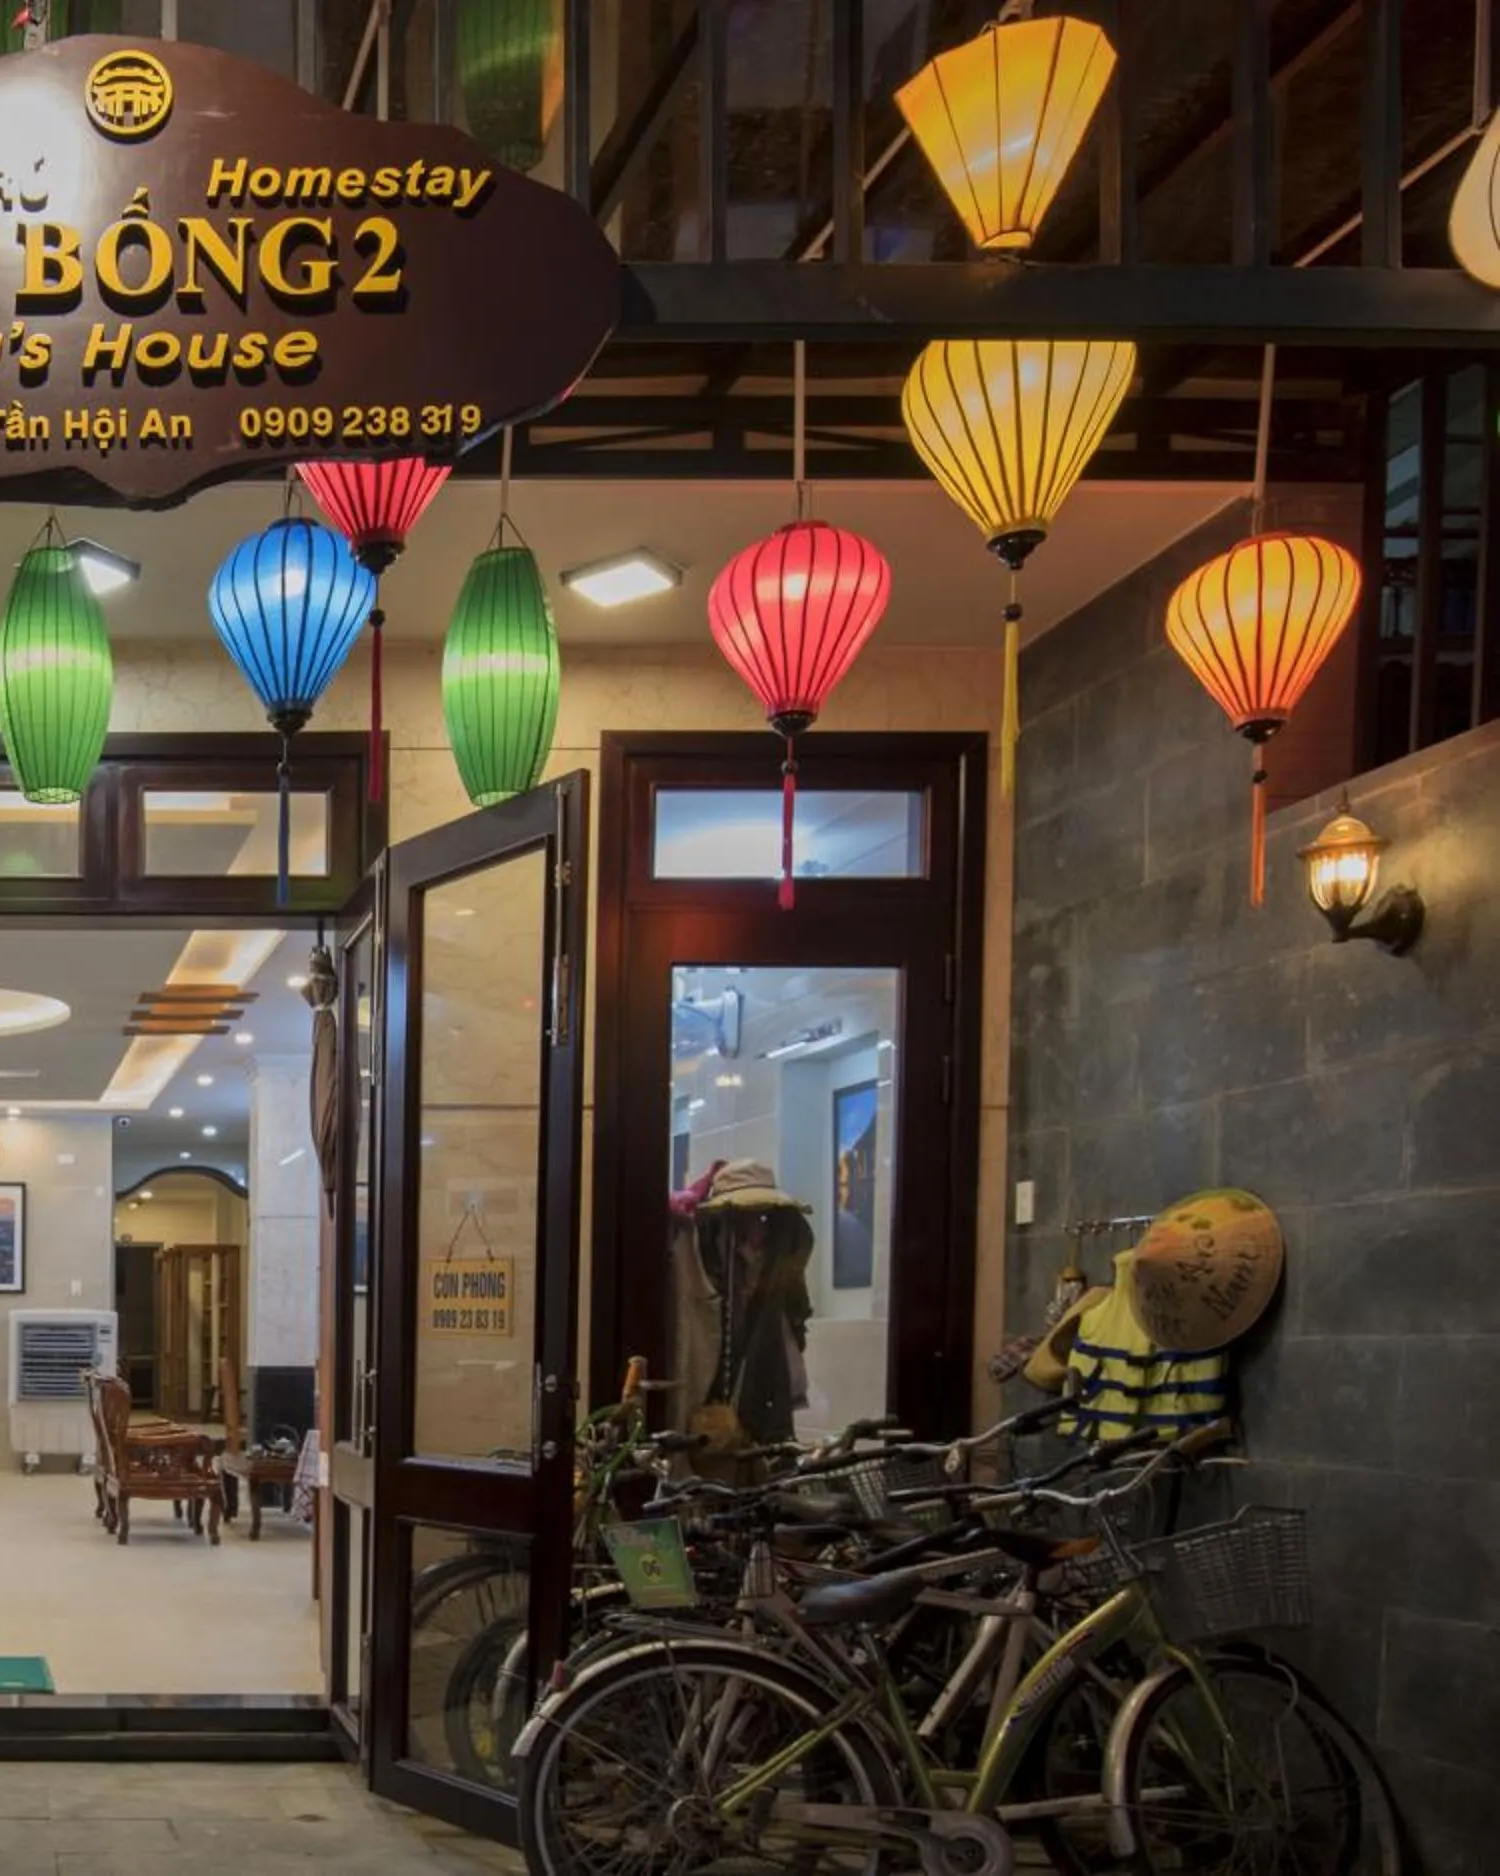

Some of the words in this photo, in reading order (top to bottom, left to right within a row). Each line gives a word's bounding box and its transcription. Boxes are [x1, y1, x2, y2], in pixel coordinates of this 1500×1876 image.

[207, 158, 491, 207] Homestay
[82, 322, 318, 369] House
[64, 408, 127, 449] Hội
[140, 409, 192, 439] An
[240, 406, 333, 437] 0909
[342, 406, 410, 437] 238
